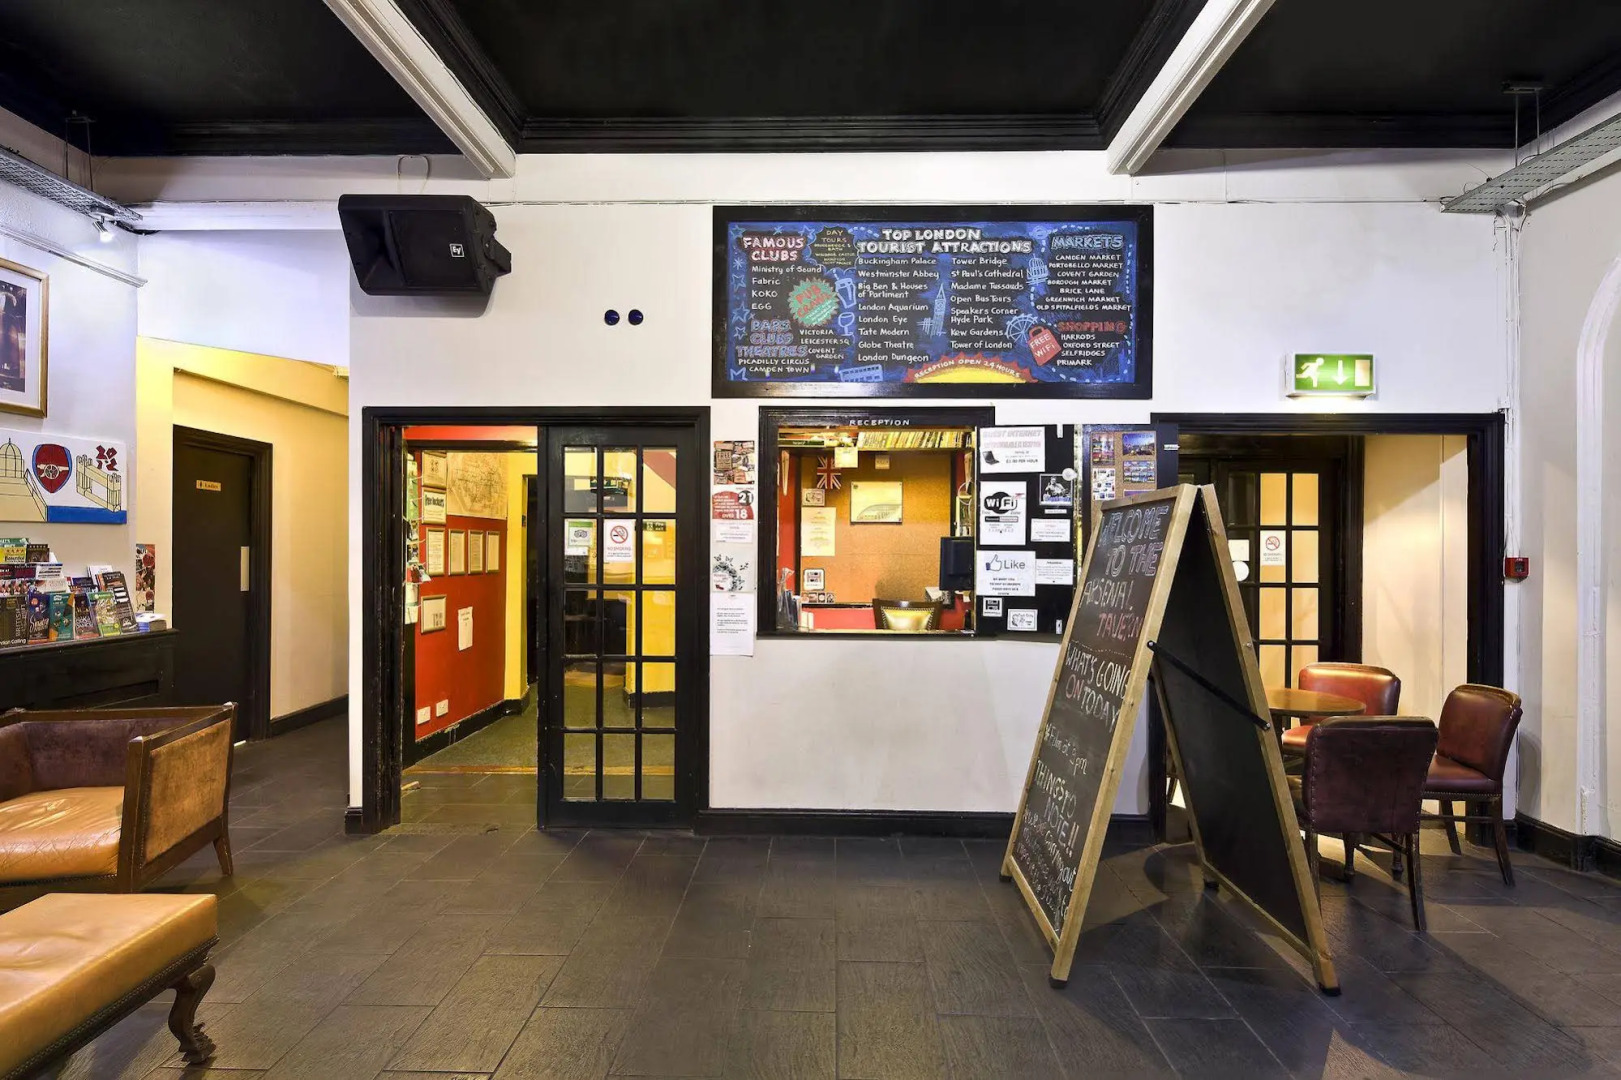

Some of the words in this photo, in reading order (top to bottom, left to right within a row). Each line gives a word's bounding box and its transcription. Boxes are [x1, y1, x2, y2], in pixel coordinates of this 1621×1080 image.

[882, 229, 909, 240] TOP
[916, 229, 981, 240] LONDON
[743, 237, 805, 248] FAMOUS
[858, 242, 925, 253] TOURIST
[932, 241, 1032, 253] ATTRACTIONS
[1051, 236, 1123, 250] MARKETS
[751, 251, 798, 261] CLUBS
[858, 258, 907, 266] Buckingham
[979, 257, 1008, 267] Bridge
[752, 265, 783, 274] Ministry
[786, 265, 795, 273] of
[796, 265, 822, 273] Sound
[951, 270, 960, 278] St
[962, 270, 983, 278] Paul's
[984, 270, 1023, 278] Cathedral
[858, 270, 910, 278] Westminster
[912, 270, 939, 280] Abbey
[752, 277, 780, 285] Fabric
[992, 282, 1024, 290] Tussauds
[858, 283, 870, 292] Big
[752, 290, 778, 298] KOKO
[858, 290, 866, 298] of
[869, 290, 909, 298] Parliment
[951, 295, 972, 304] Open
[858, 303, 886, 311] London
[888, 303, 928, 313] Aquarium
[951, 308, 989, 316] Speakers
[858, 316, 888, 324] London
[893, 316, 908, 325] Eye
[951, 316, 970, 325] Hyde
[750, 320, 790, 332] BARS
[1058, 321, 1126, 333] SHOPPING
[877, 328, 909, 336] Modern
[970, 328, 1003, 336] Gardens
[750, 333, 793, 344] CLUBS
[1030, 333, 1050, 350] FREE
[858, 341, 881, 349] Globe
[883, 341, 914, 349] Theatre
[950, 341, 974, 349] Tower
[975, 341, 983, 349] of
[984, 341, 1012, 349] London
[736, 346, 808, 357] THEATRES
[858, 353, 888, 361] London
[892, 353, 929, 364] Dungeon
[914, 360, 955, 378] RECEPTION
[984, 360, 994, 368] 24
[996, 364, 1020, 378] HOURS
[738, 493, 752, 504] 21
[735, 509, 748, 519] 18
[1098, 505, 1169, 547] WELCOME
[1004, 560, 1026, 569] Like
[1105, 544, 1126, 577] TO
[1129, 542, 1163, 576] THE
[1080, 578, 1134, 610] ARSENAL
[1096, 613, 1143, 642] TAVERN
[1096, 660, 1131, 700] GOING
[1066, 674, 1084, 700] ON
[1081, 686, 1121, 733] TODAY
[1036, 758, 1066, 801] THINGS
[1061, 789, 1077, 818] TO
